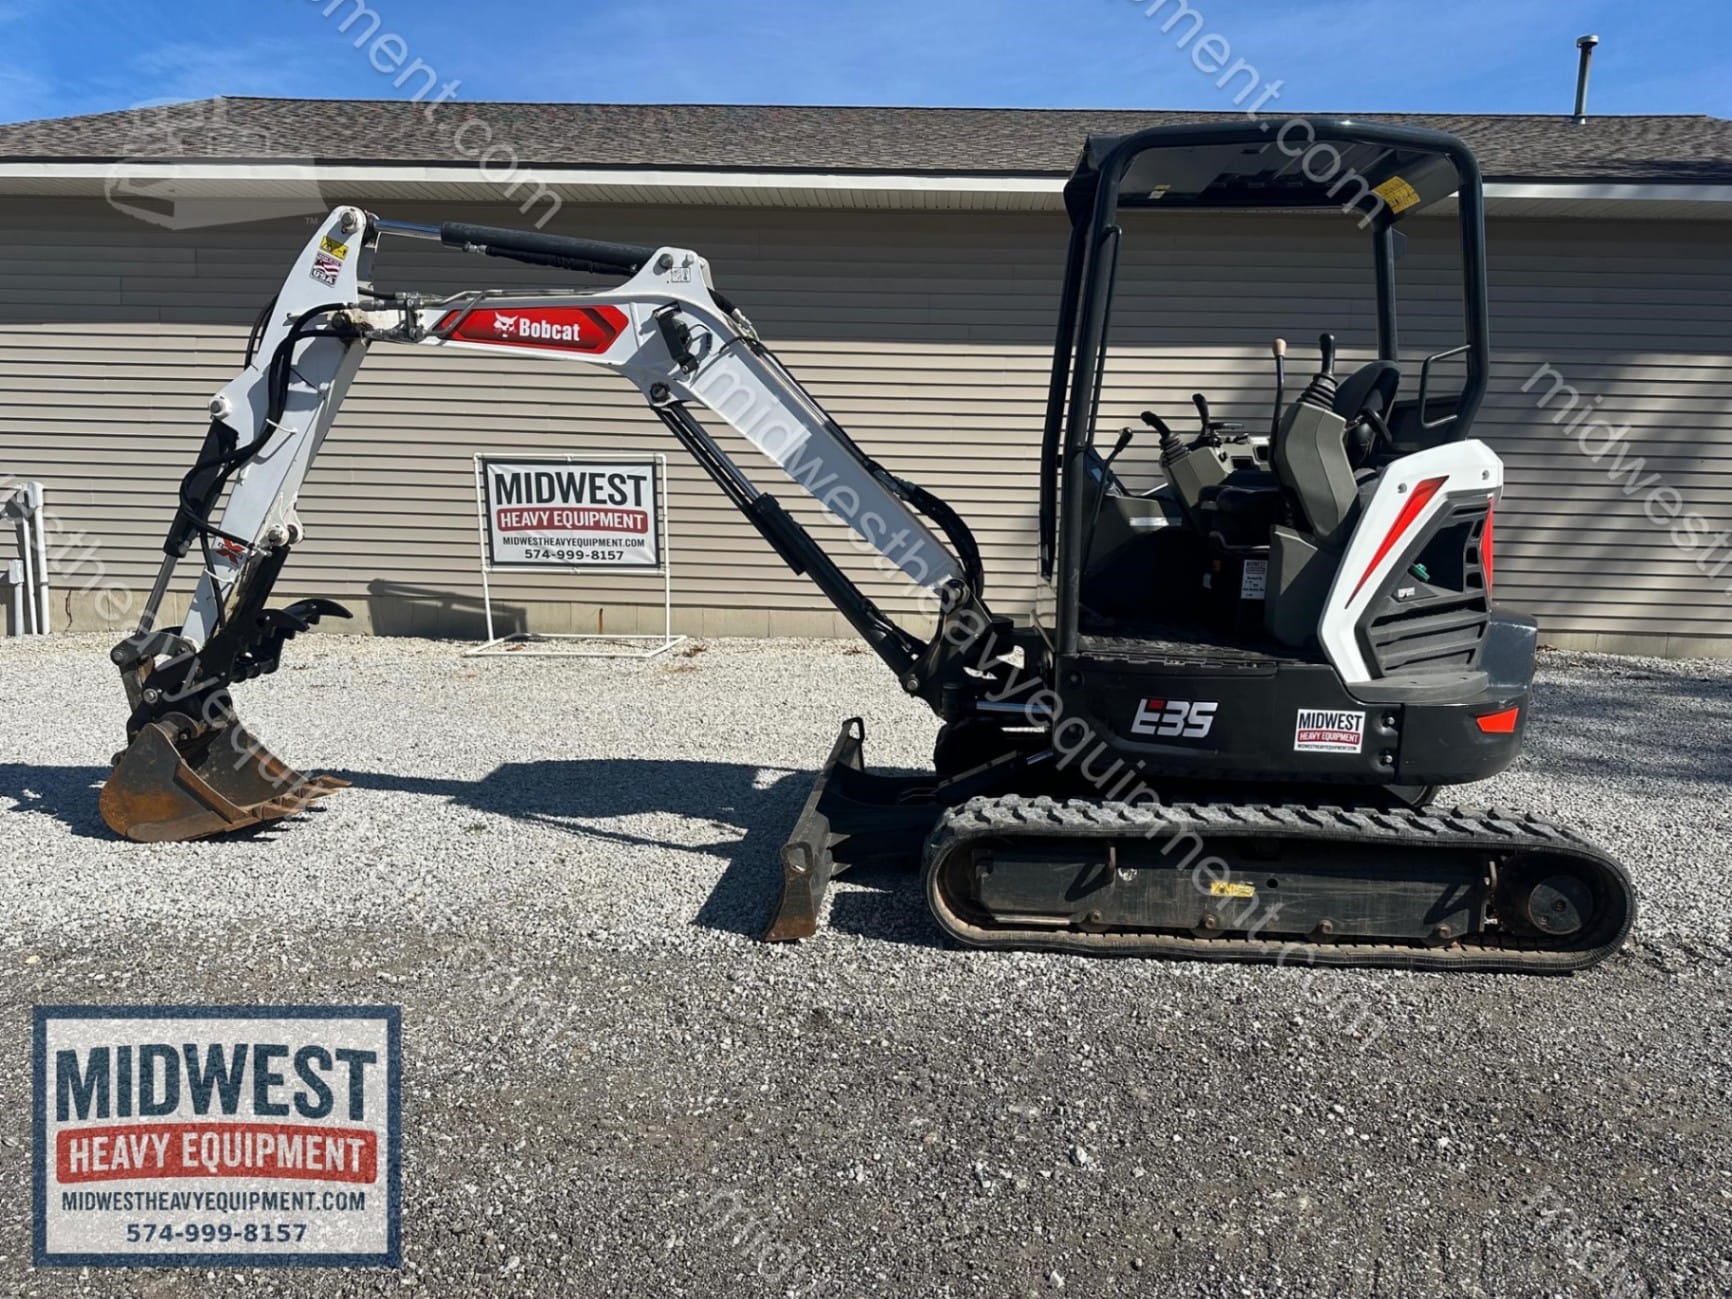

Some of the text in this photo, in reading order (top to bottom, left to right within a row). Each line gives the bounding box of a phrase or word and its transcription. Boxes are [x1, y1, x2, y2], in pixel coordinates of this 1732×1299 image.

[519, 318, 580, 341] Bobcat
[494, 472, 647, 506] MIDWEST
[501, 510, 644, 530] HEAVY EQUIPMENT
[503, 536, 645, 548] MIDWESTHEAVYEQUIPMENT.COM
[524, 549, 624, 560] 574-999-8157
[1130, 698, 1218, 738] E35
[1299, 712, 1362, 731] MIDWEST
[1299, 732, 1359, 743] HEAVY EQUIPMENT
